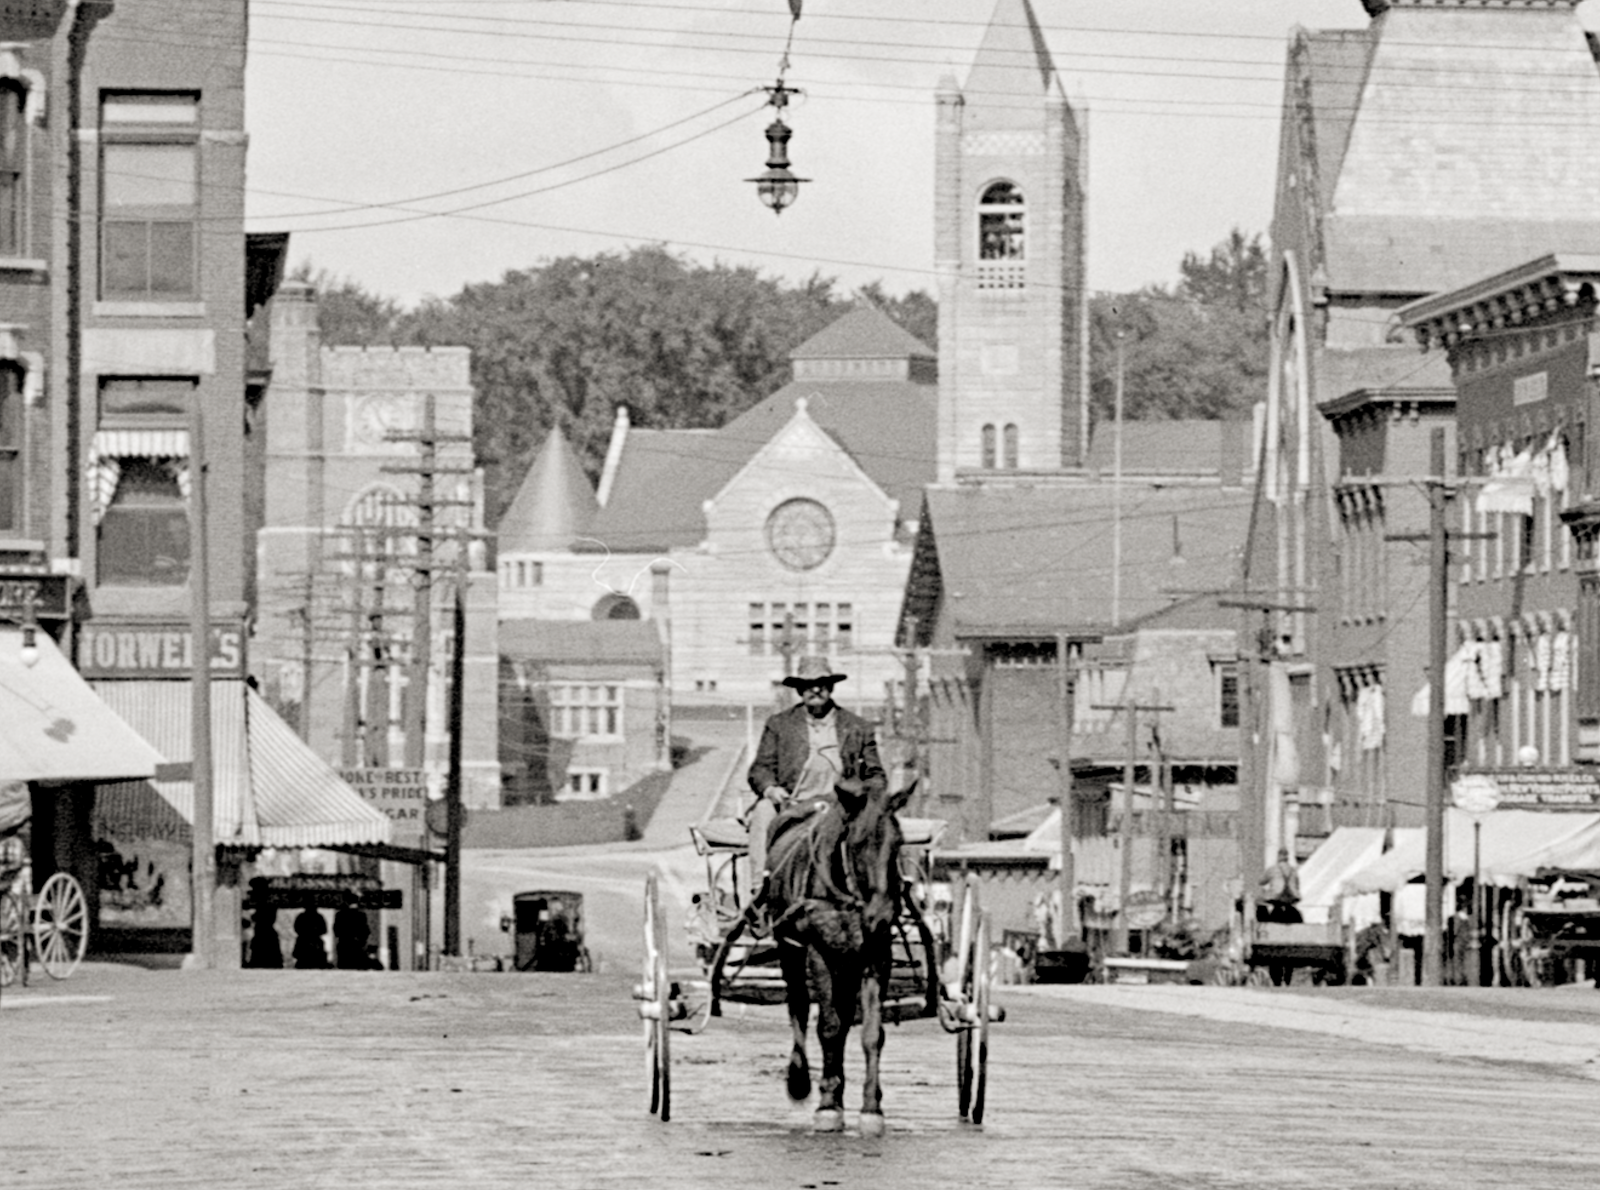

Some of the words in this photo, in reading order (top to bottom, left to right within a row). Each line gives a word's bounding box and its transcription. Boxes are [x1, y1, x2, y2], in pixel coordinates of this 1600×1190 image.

[79, 629, 240, 668] NORWE'S
[385, 771, 420, 785] BEST
[382, 787, 423, 799] PRIDE
[380, 808, 419, 820] GAR
